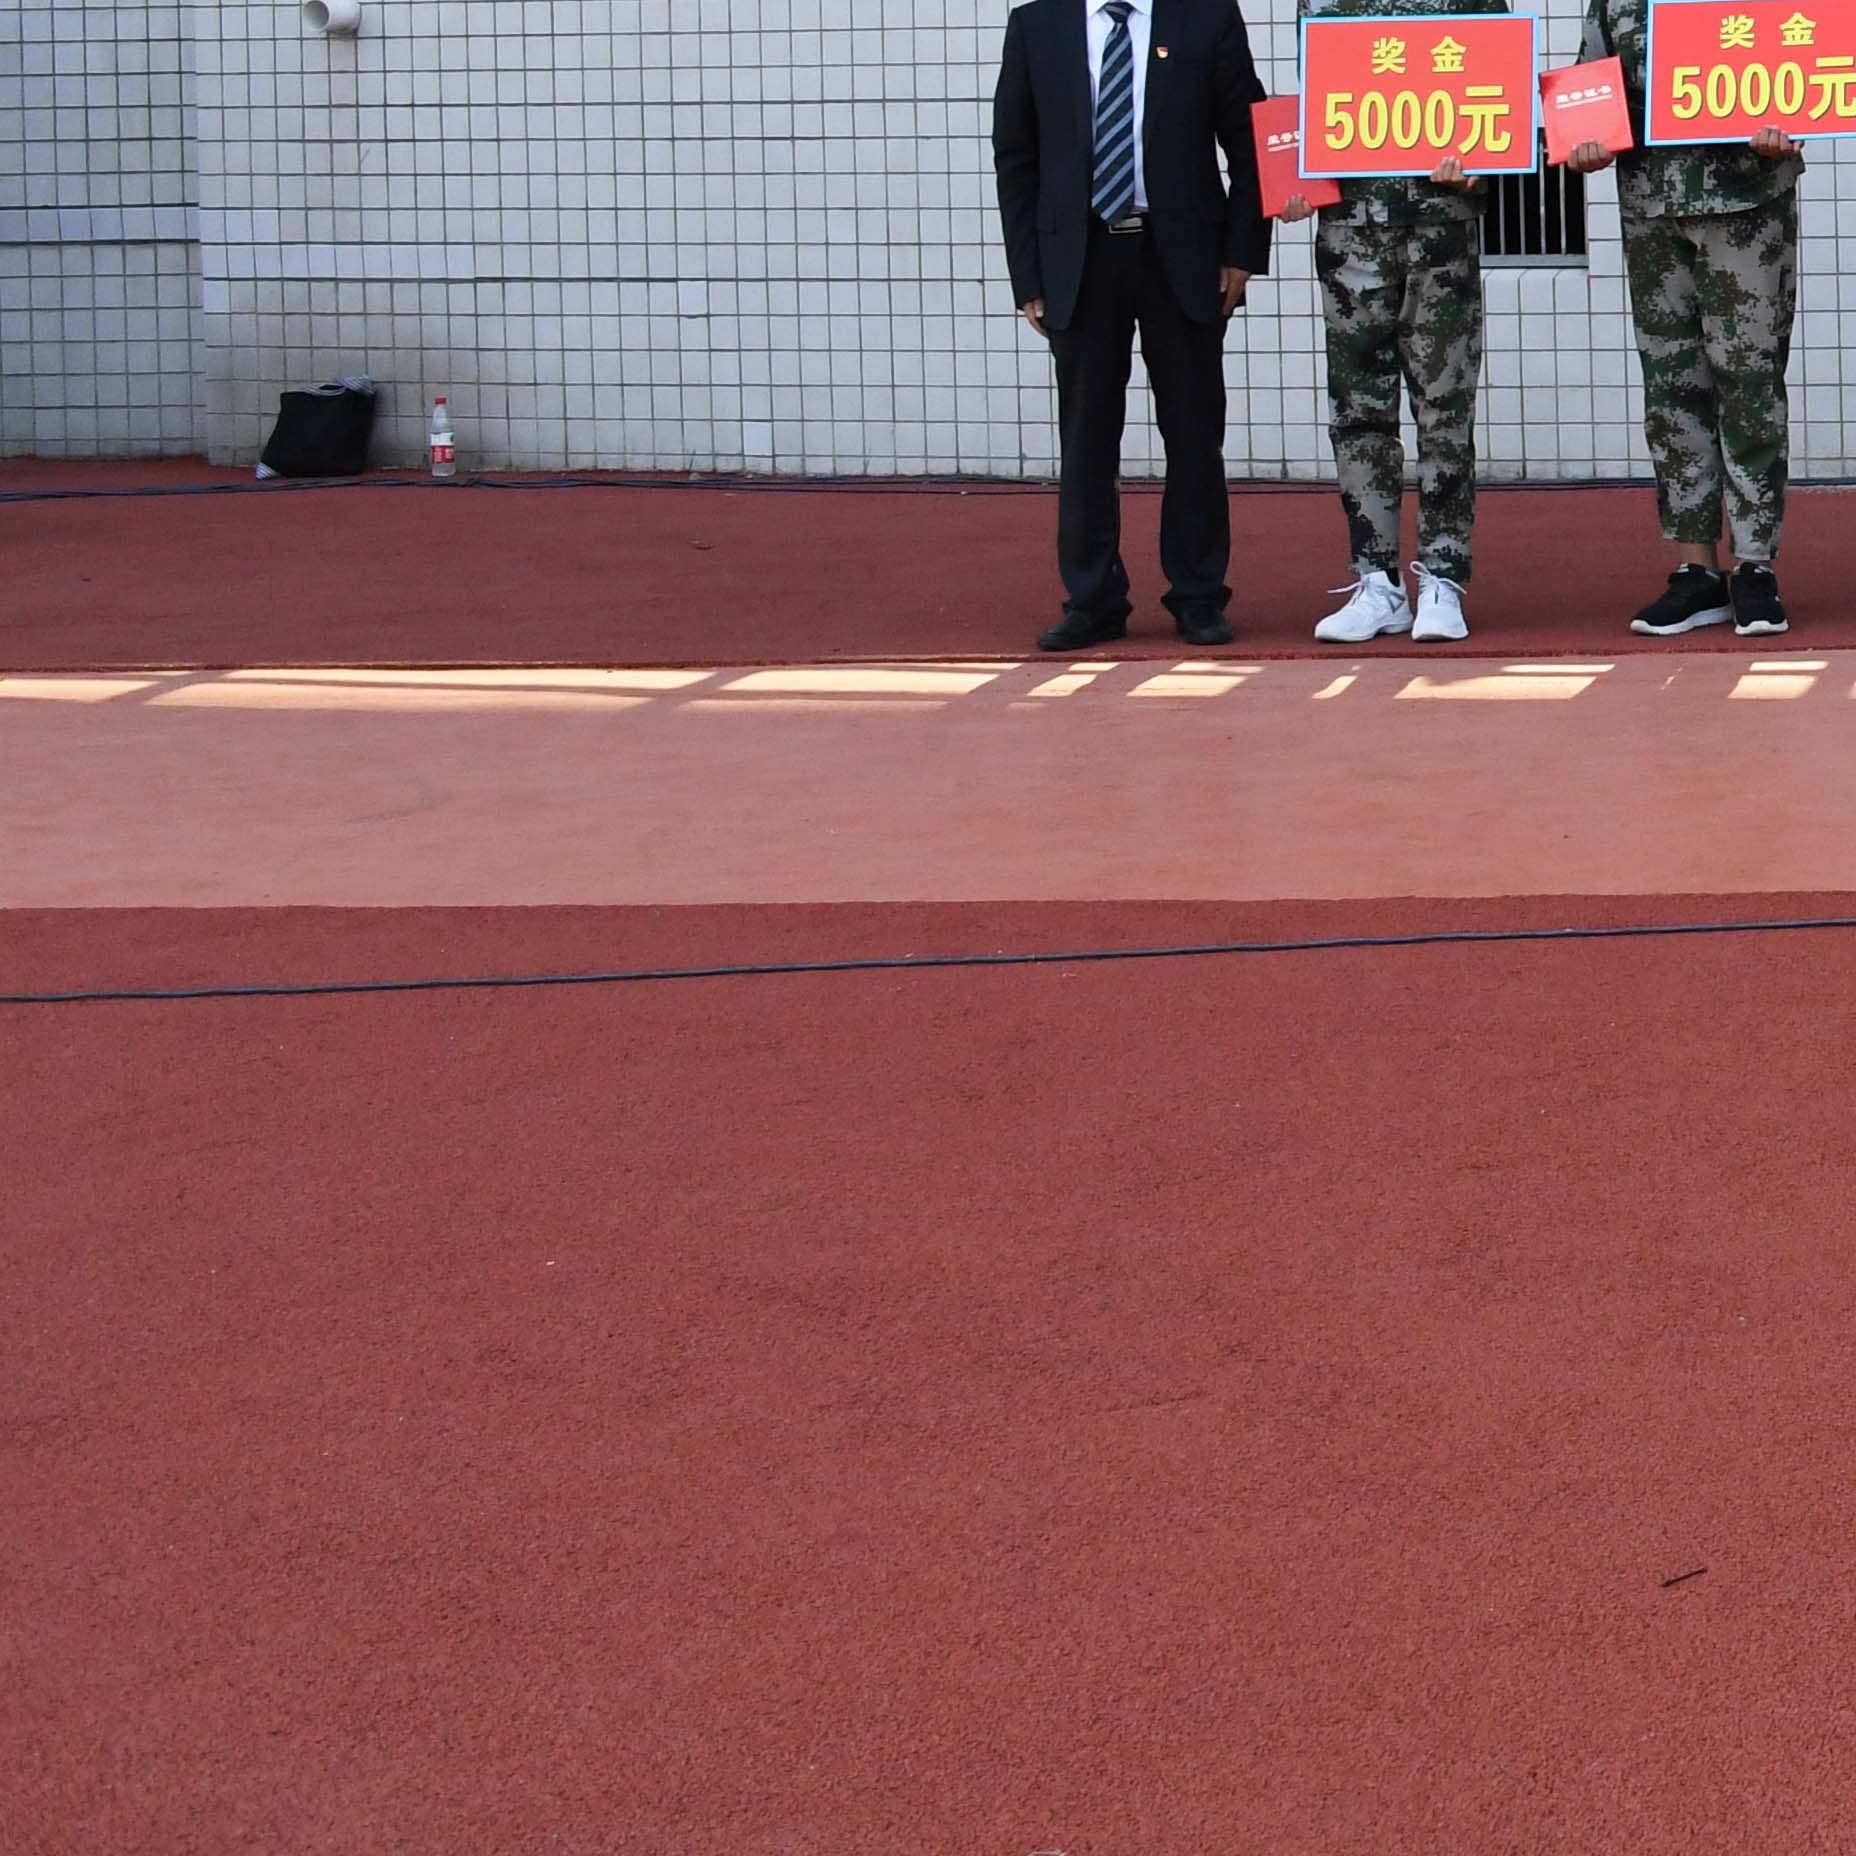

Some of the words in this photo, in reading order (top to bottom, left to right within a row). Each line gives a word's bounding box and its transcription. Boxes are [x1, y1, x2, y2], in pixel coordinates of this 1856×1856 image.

[1720, 12, 1816, 49] 奖金
[1371, 36, 1466, 75] 奖金
[1324, 85, 1512, 154] 5000元
